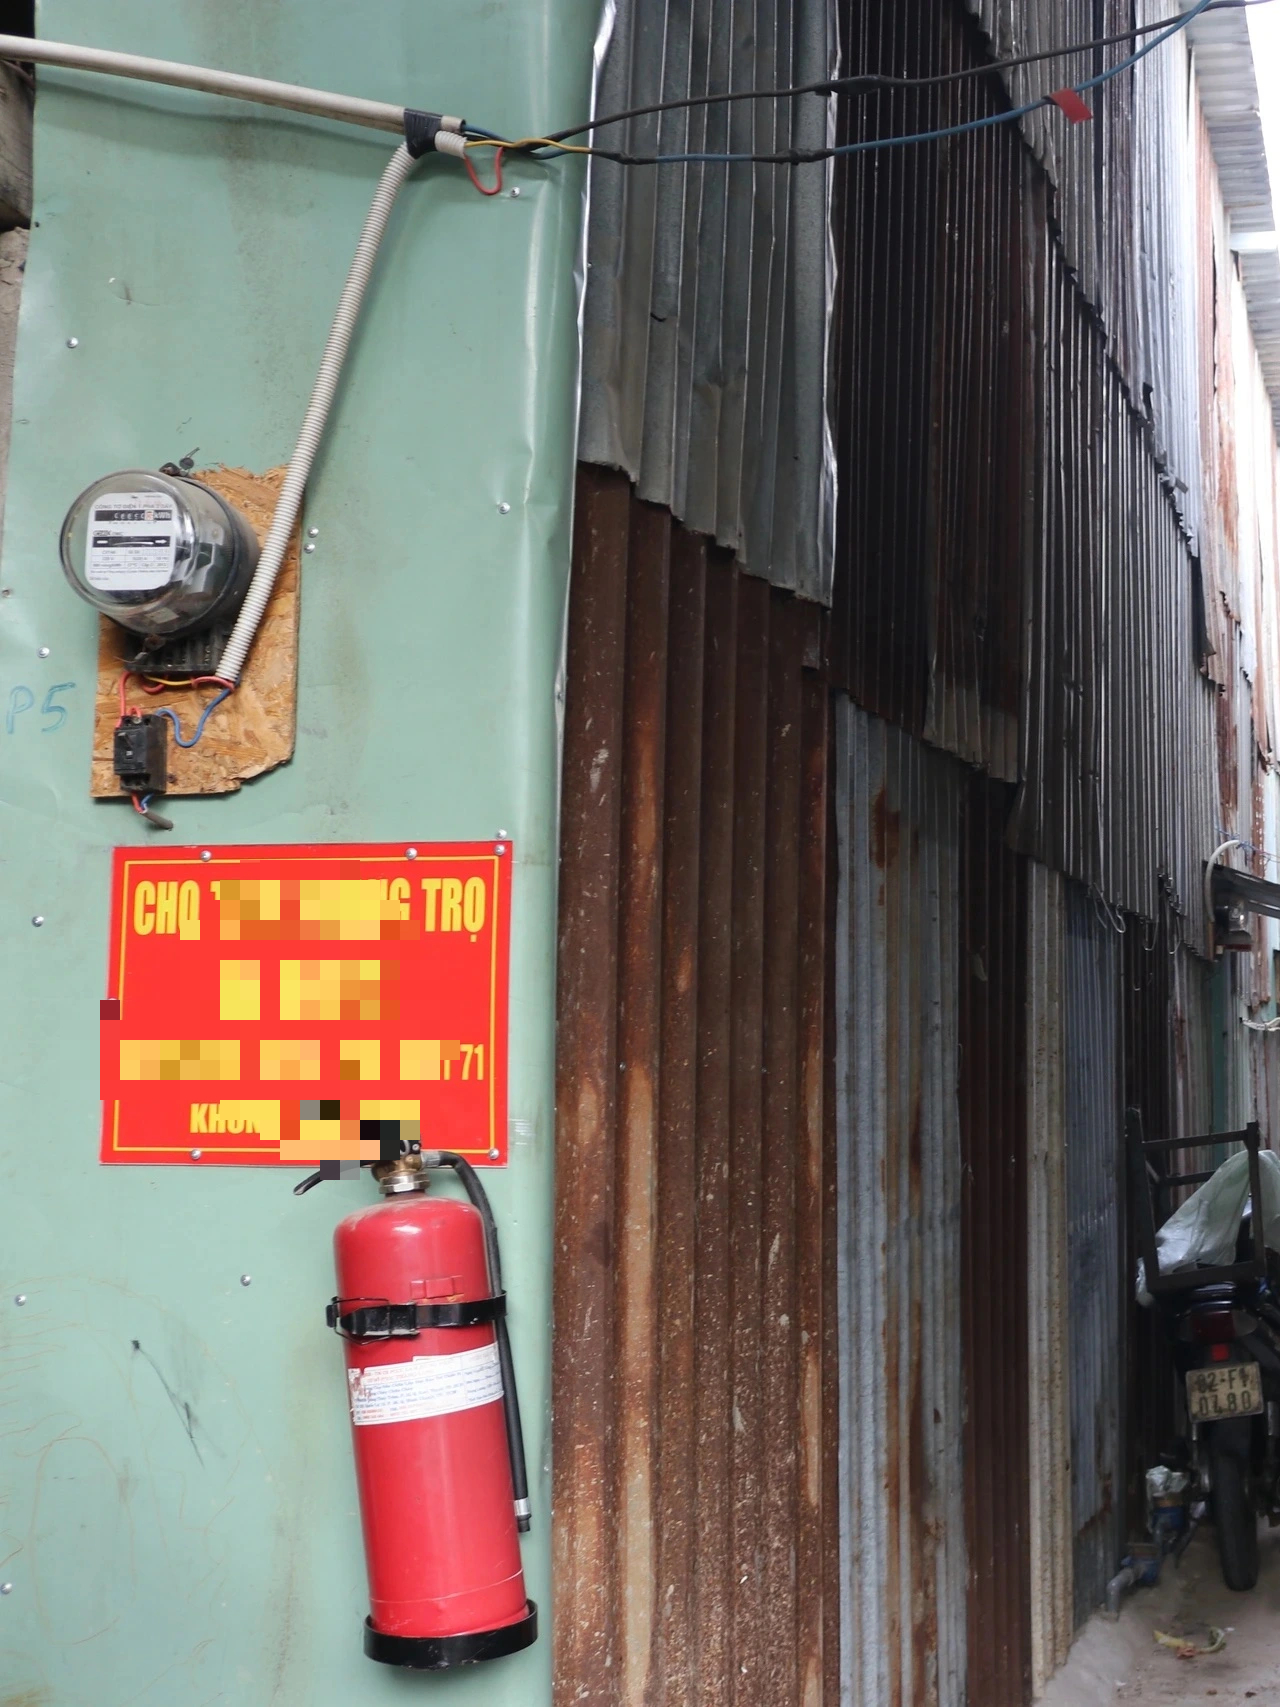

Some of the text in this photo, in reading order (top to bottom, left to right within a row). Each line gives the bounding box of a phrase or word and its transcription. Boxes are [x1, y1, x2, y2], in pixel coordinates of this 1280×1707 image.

[153, 511, 171, 520] kWh
[5, 681, 76, 735] P5
[421, 876, 487, 943] TRỌ
[460, 1043, 485, 1081] 71
